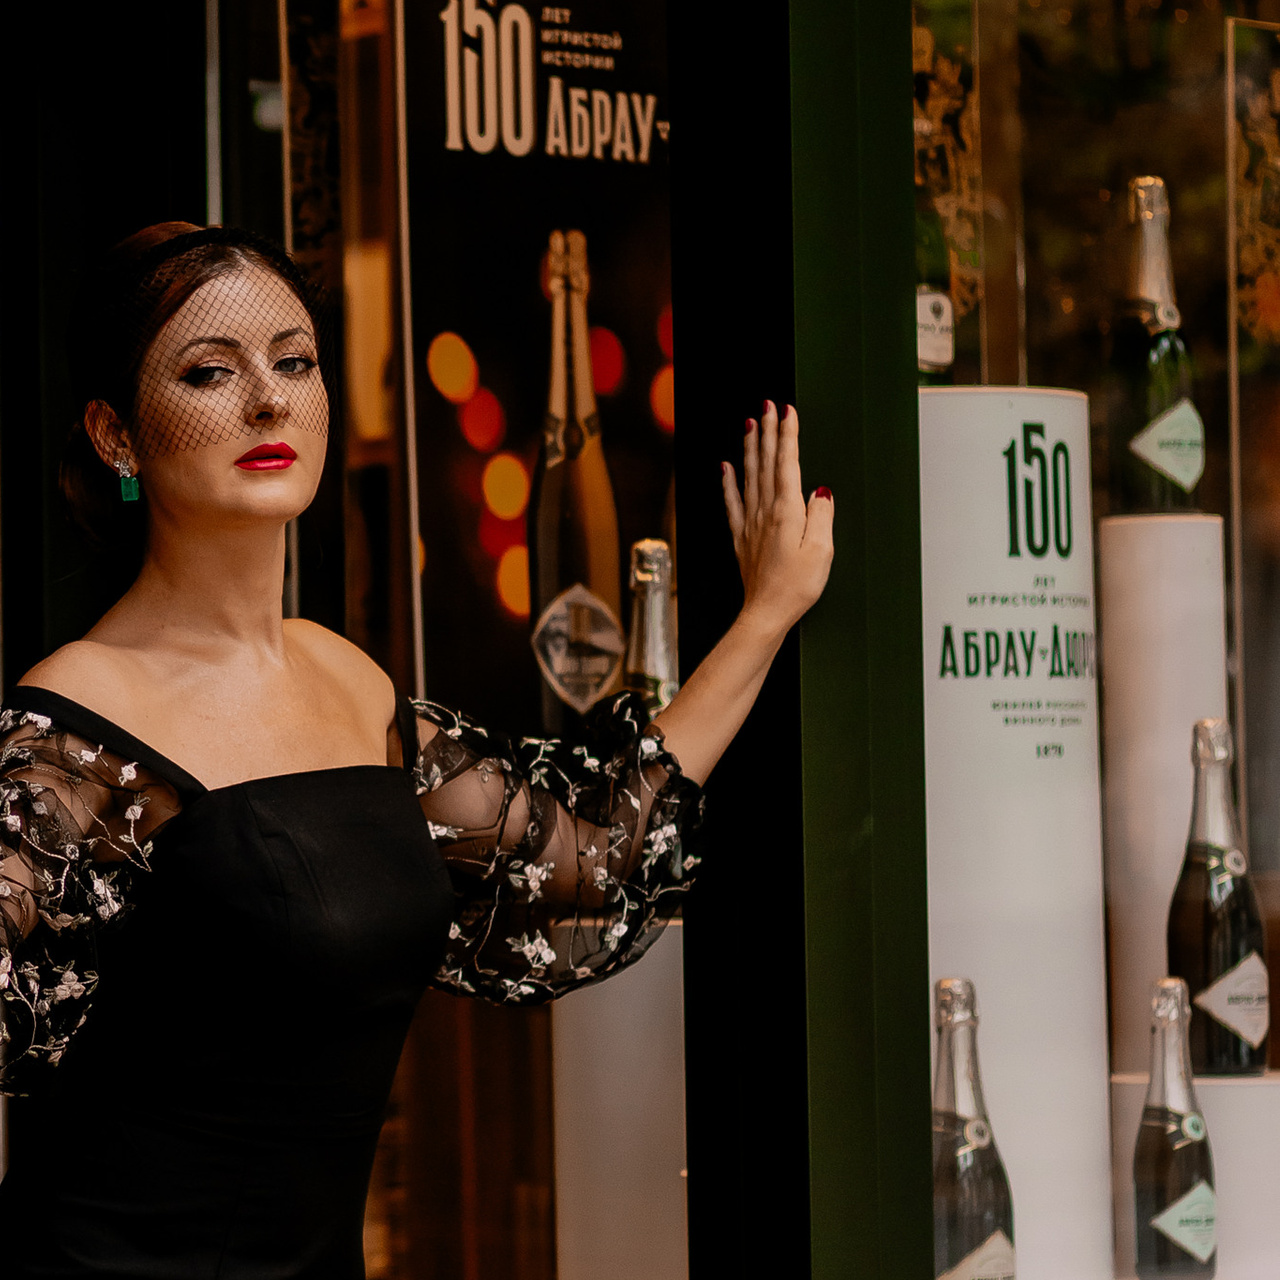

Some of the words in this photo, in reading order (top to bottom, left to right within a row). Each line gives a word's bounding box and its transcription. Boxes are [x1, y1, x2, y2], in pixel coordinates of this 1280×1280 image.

[541, 28, 622, 50] ИГРИСТОЙ
[541, 50, 615, 70] ИСТОРИИ
[1002, 422, 1072, 558] 150
[967, 593, 1047, 608] ИГРИСТОЙ
